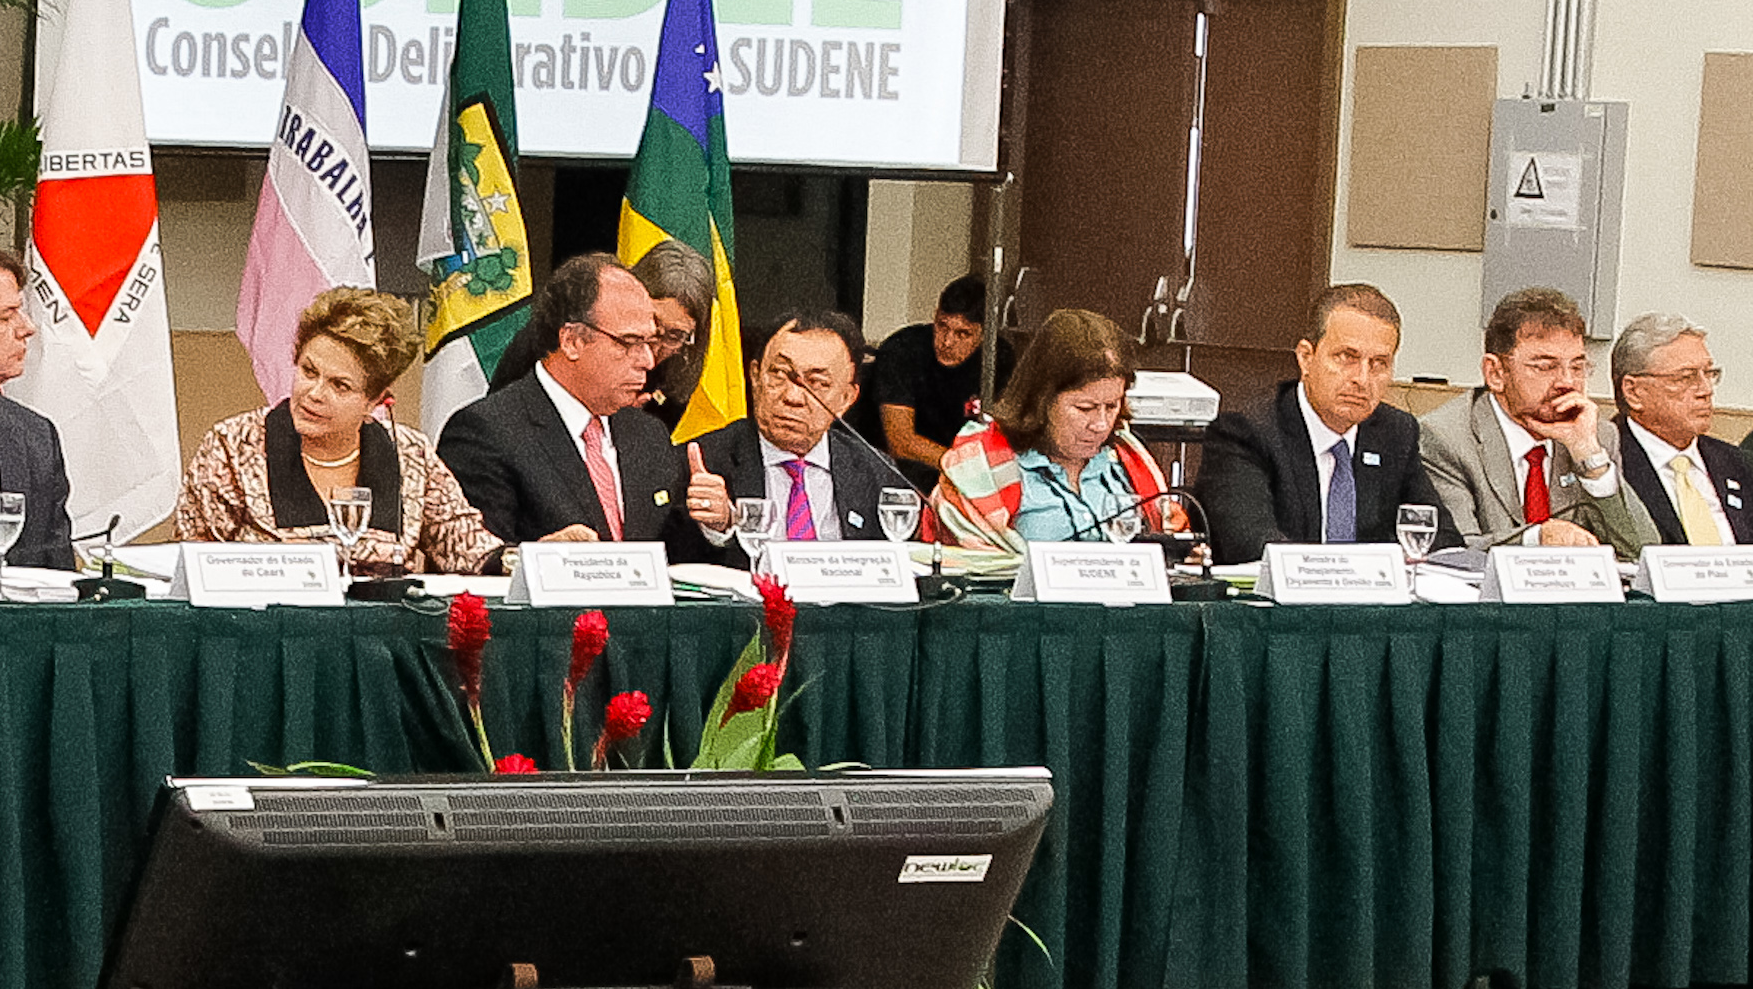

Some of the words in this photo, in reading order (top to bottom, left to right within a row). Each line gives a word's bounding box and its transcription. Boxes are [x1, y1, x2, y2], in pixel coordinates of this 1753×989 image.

[146, 17, 293, 79] Consel
[368, 24, 646, 93] Delirativo
[728, 37, 901, 100] SUDENE
[44, 152, 145, 172] IBERTAS
[113, 263, 156, 323] SERA
[206, 555, 263, 565] Governador
[281, 555, 315, 565] Estado
